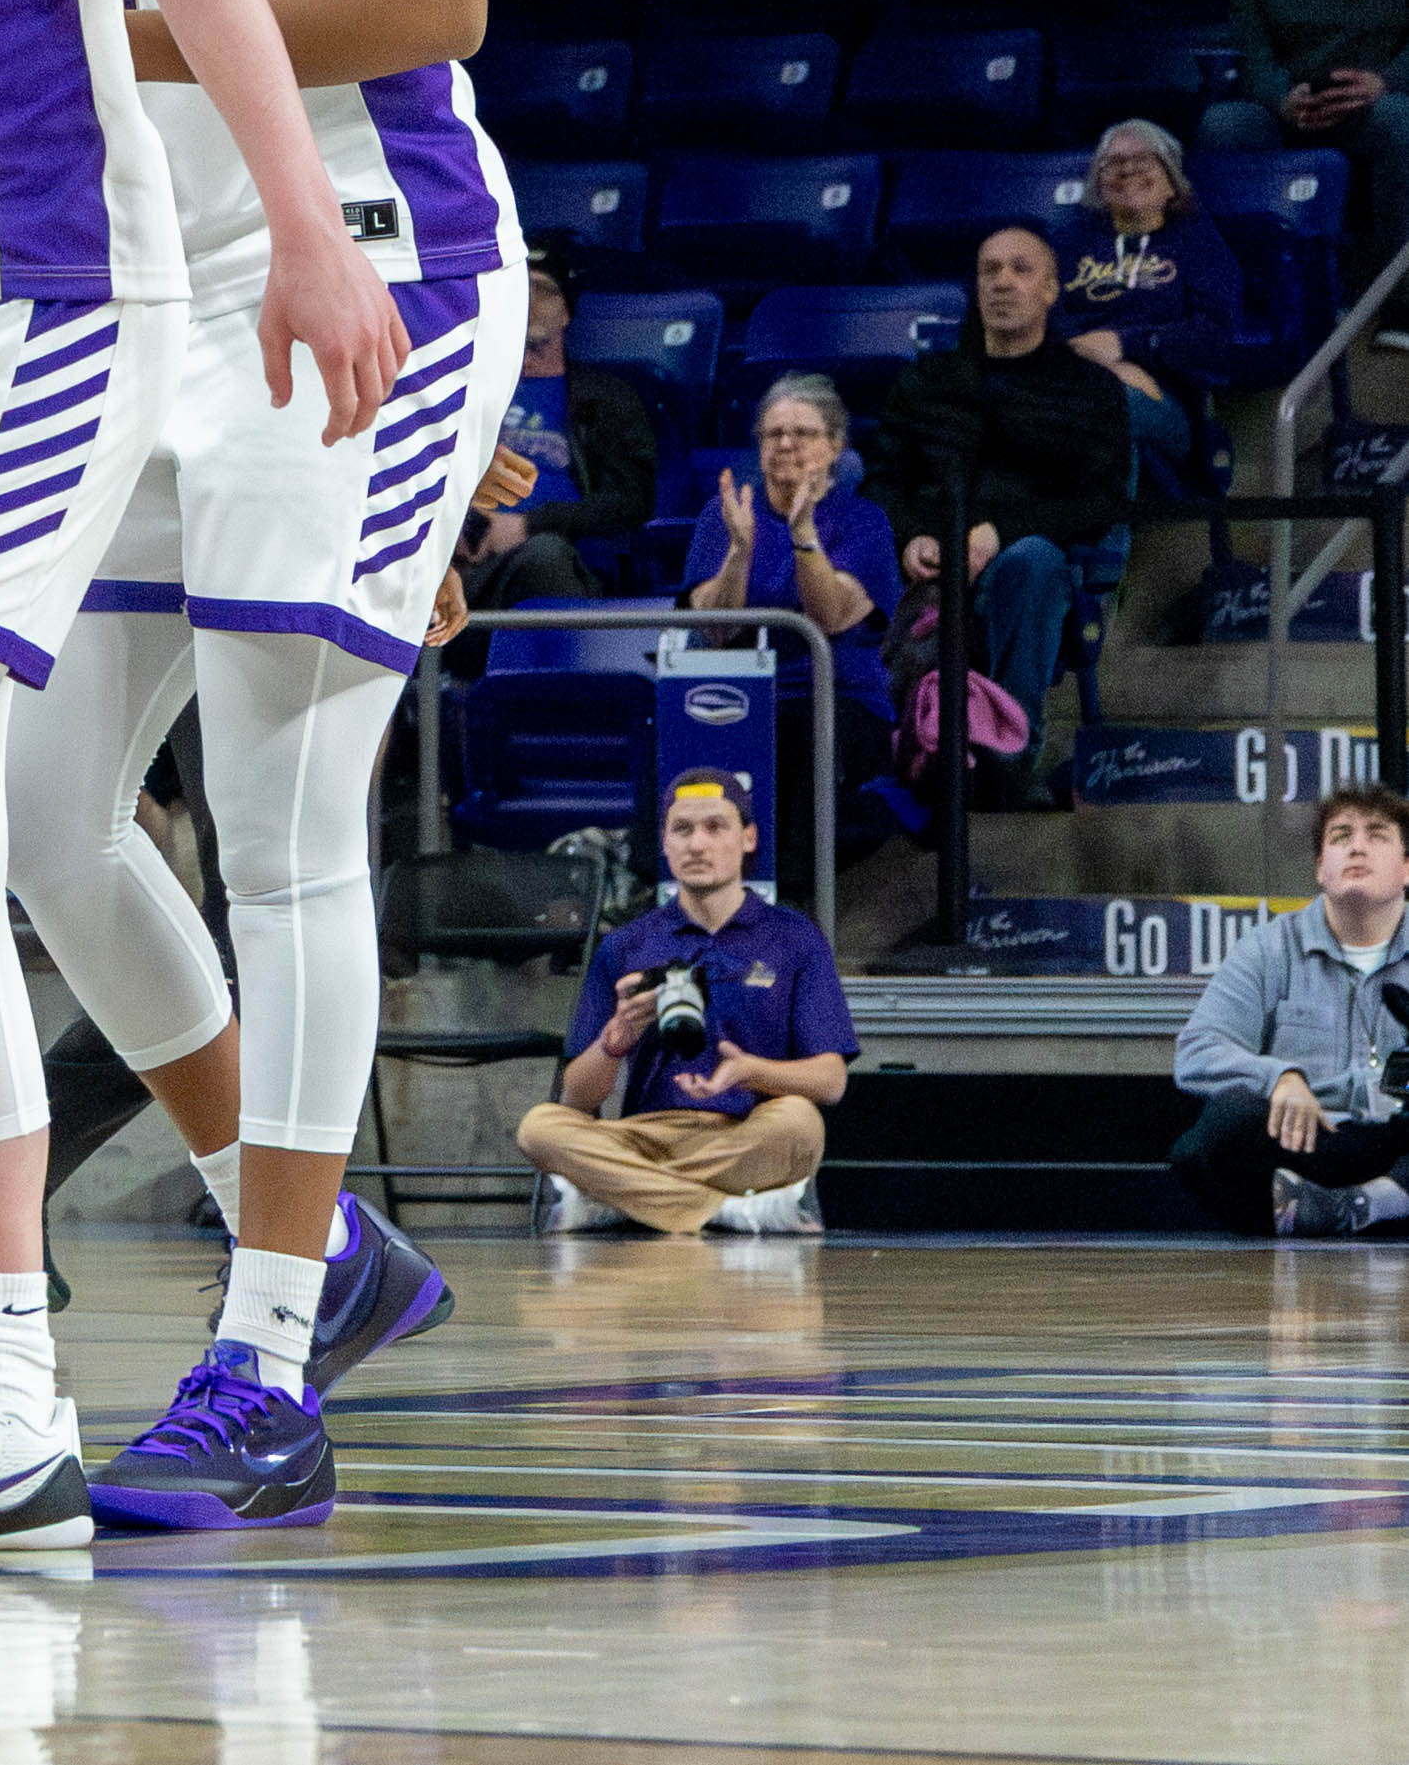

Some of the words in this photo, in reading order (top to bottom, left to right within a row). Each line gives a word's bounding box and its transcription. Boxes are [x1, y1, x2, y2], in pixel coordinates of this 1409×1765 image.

[1319, 727, 1380, 801] Du
[1104, 898, 1168, 977] Go
[1189, 897, 1270, 977] Du
